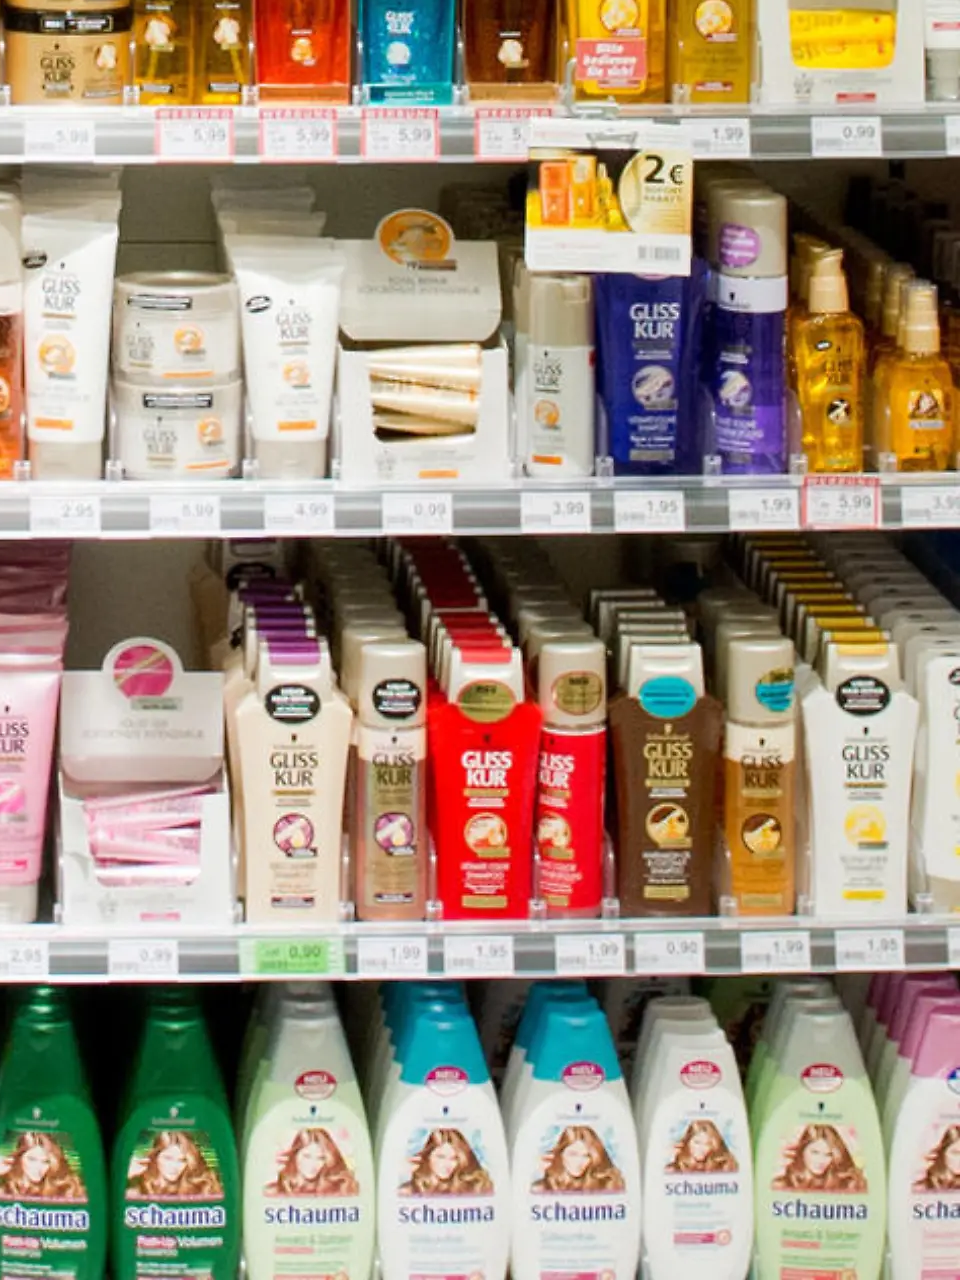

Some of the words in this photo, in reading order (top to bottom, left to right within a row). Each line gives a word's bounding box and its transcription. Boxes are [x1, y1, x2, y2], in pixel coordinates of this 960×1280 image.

[42, 278, 81, 295] GLISS
[45, 294, 75, 310] KUR
[630, 304, 680, 320] GLISS
[634, 321, 674, 339] KUR
[270, 752, 318, 768] GLISS
[643, 743, 693, 760] GLISS
[842, 746, 890, 761] GLISS
[462, 752, 512, 769] GLISS
[274, 770, 313, 786] KUR
[466, 769, 507, 787] KUR
[648, 761, 688, 778] KUR
[846, 763, 885, 779] KUR
[665, 1180, 739, 1196] schauma
[126, 1206, 224, 1227] schauma
[264, 1205, 360, 1224] schauma
[398, 1205, 495, 1222] schauma
[530, 1202, 626, 1221] schauma
[771, 1200, 868, 1220] schauma
[913, 1200, 960, 1220] scha
